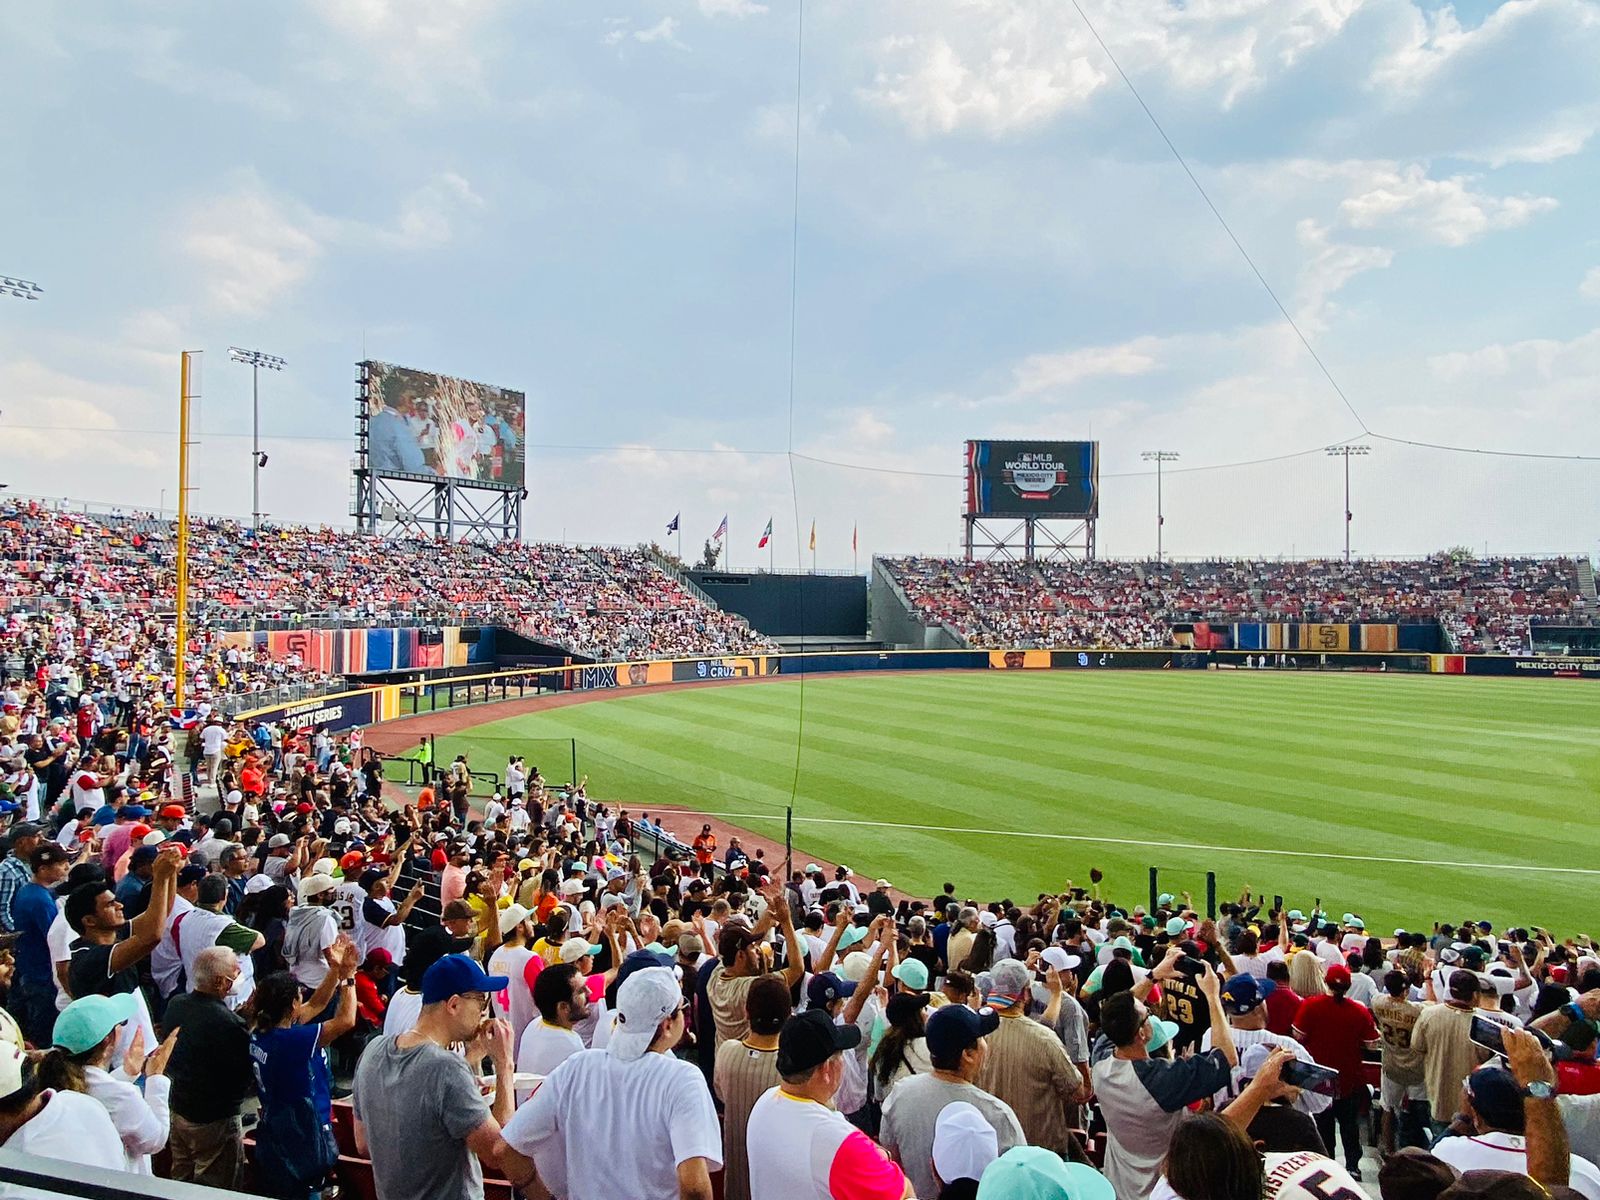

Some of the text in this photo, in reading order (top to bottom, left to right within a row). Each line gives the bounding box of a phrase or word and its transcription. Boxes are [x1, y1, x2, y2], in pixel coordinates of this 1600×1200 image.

[1033, 453, 1053, 462] MLB
[1005, 461, 1065, 470] WORLD TOUR
[1515, 661, 1557, 669] MEXICO
[1557, 662, 1581, 670] CITY
[710, 667, 736, 677] CRUZ
[582, 666, 616, 690] MX
[297, 712, 314, 728] CITY
[314, 705, 343, 725] SERIES
[1167, 993, 1194, 1024] 23
